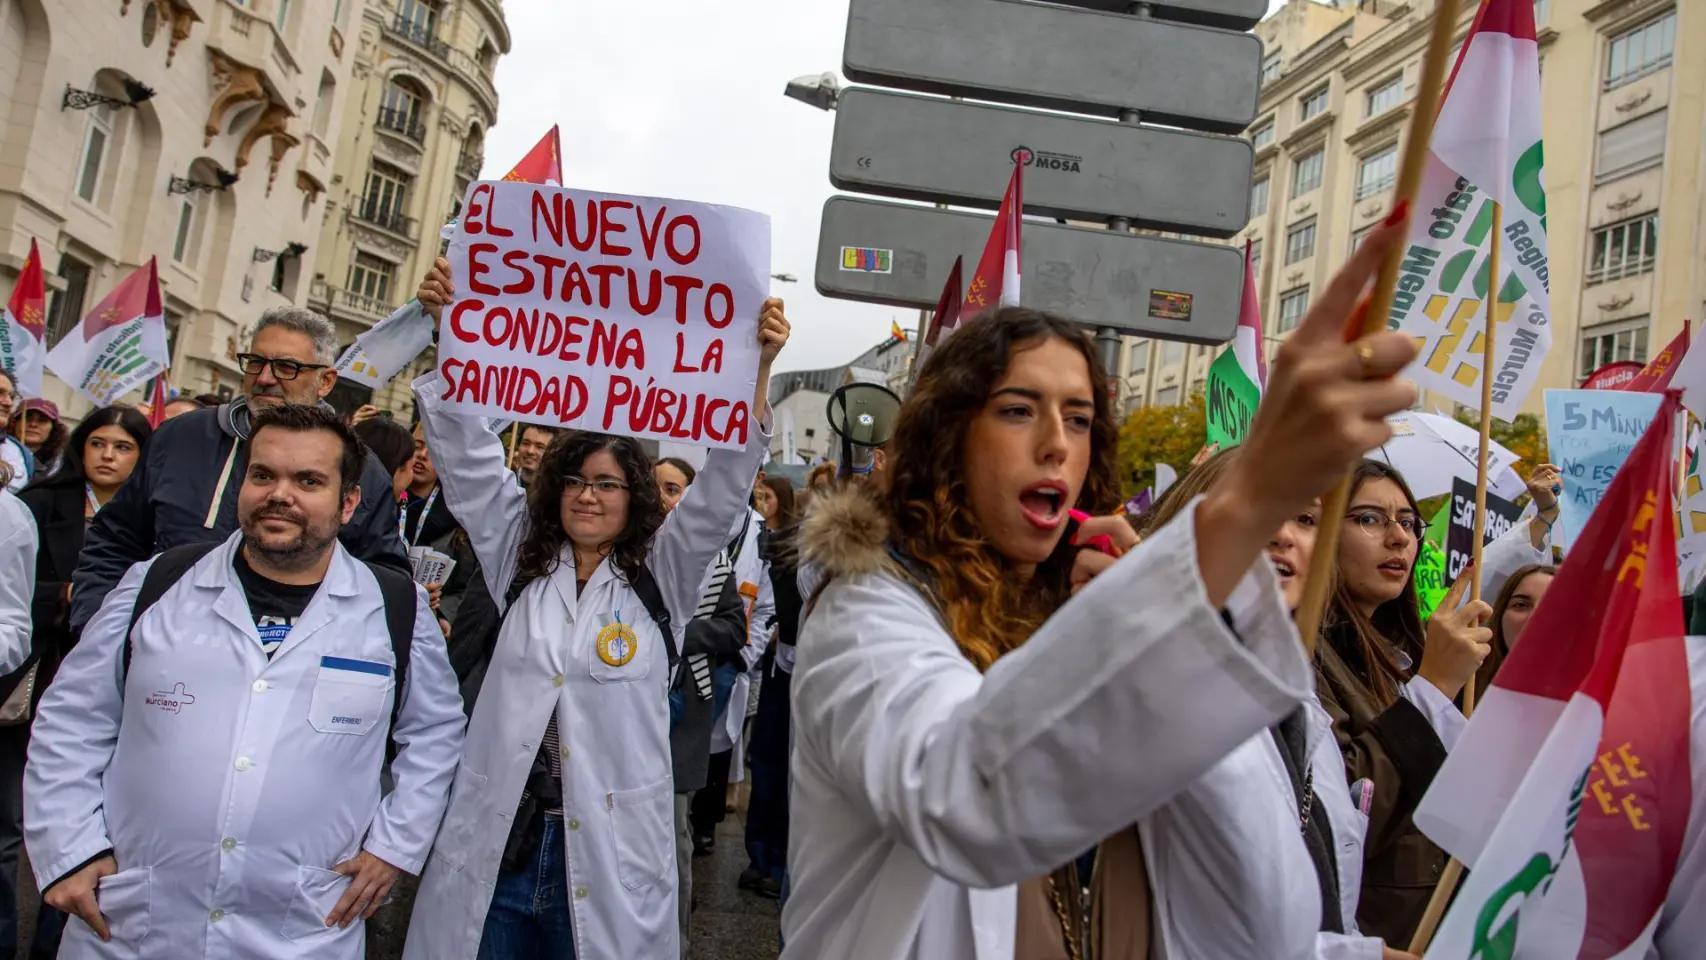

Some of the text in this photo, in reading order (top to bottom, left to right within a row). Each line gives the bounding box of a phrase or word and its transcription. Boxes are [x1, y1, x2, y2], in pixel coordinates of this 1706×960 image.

[1036, 157, 1081, 173] MOSA
[463, 183, 701, 265] EL NUEVO
[468, 243, 734, 329] ESTATUTO
[450, 299, 723, 373] CONDENA LA
[440, 357, 748, 444] SANIDAD PÚBLICA
[1209, 372, 1237, 440] MIS
[1562, 402, 1587, 431] 5
[1561, 456, 1585, 478] NO
